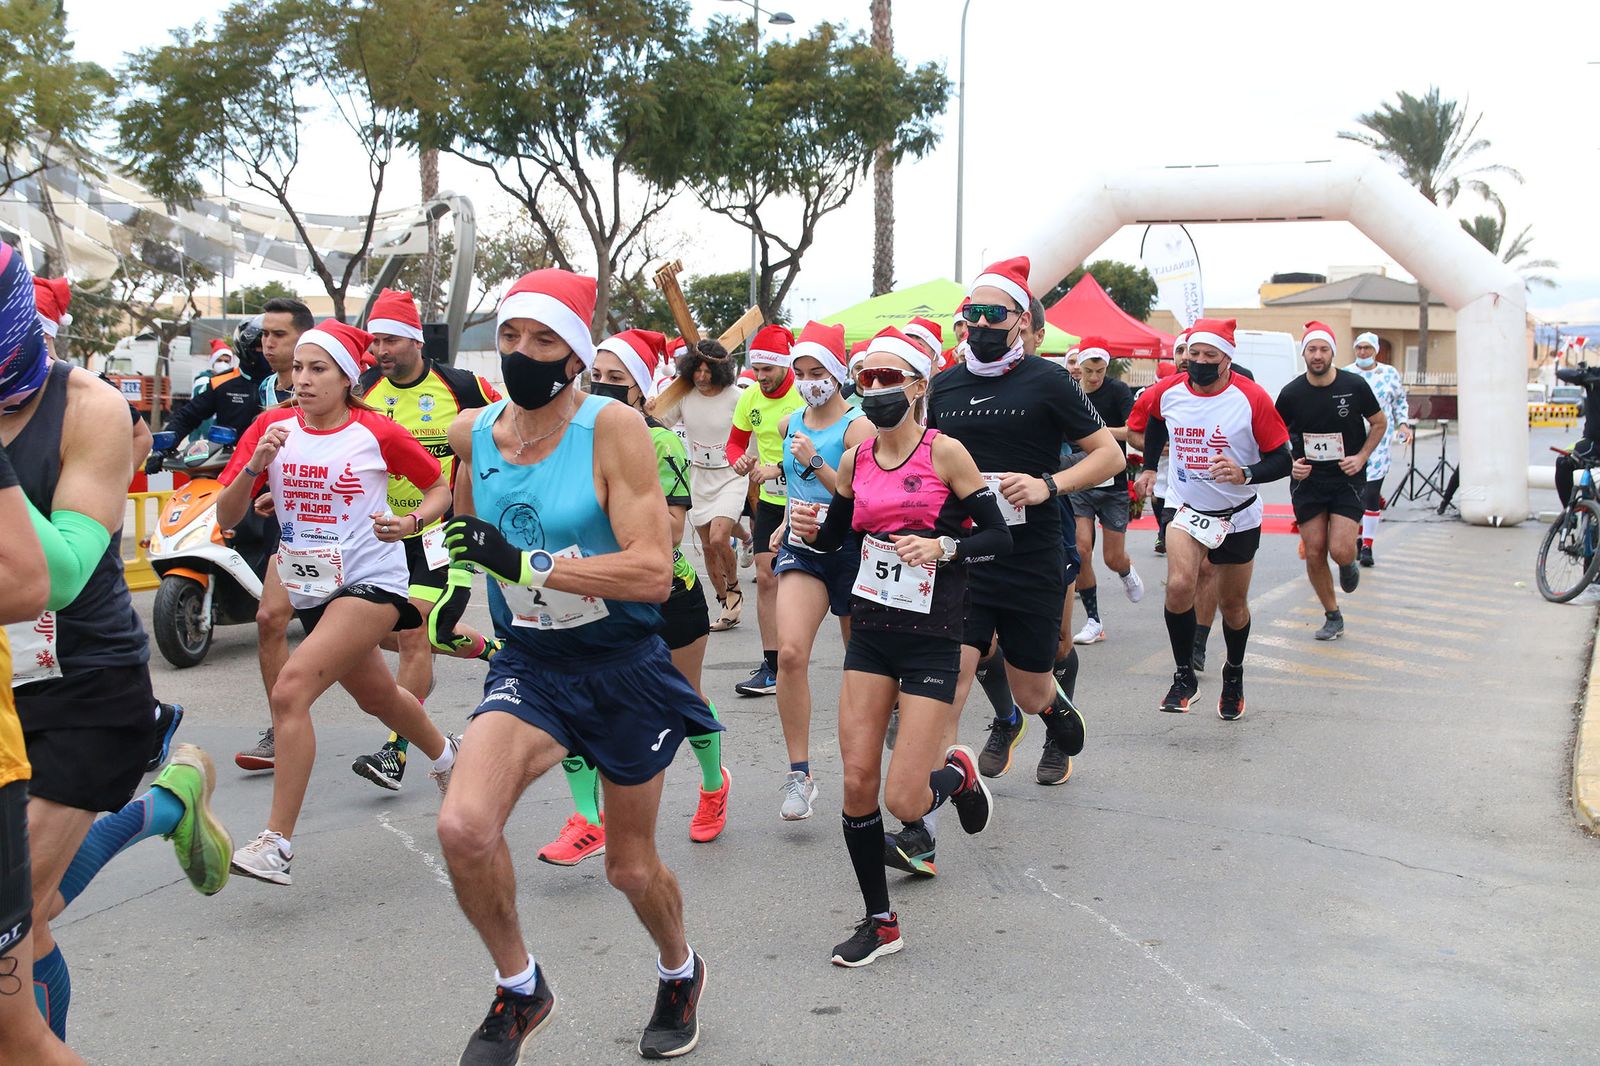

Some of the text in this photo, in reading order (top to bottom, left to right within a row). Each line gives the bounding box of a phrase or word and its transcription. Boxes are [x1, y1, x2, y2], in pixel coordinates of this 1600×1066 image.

[1174, 428, 1205, 437] XII SAN
[1174, 437, 1203, 445] SILVESTRE
[1175, 445, 1200, 453] COMARCA
[1314, 443, 1328, 451] 41
[704, 452, 710, 460] 1
[299, 465, 328, 479] SAN
[283, 478, 325, 489] SILVESTRE
[283, 490, 320, 501] COMARCA
[300, 501, 331, 514] NÍJAR
[1189, 514, 1211, 530] 20
[291, 563, 320, 578] 35
[875, 560, 902, 583] 51
